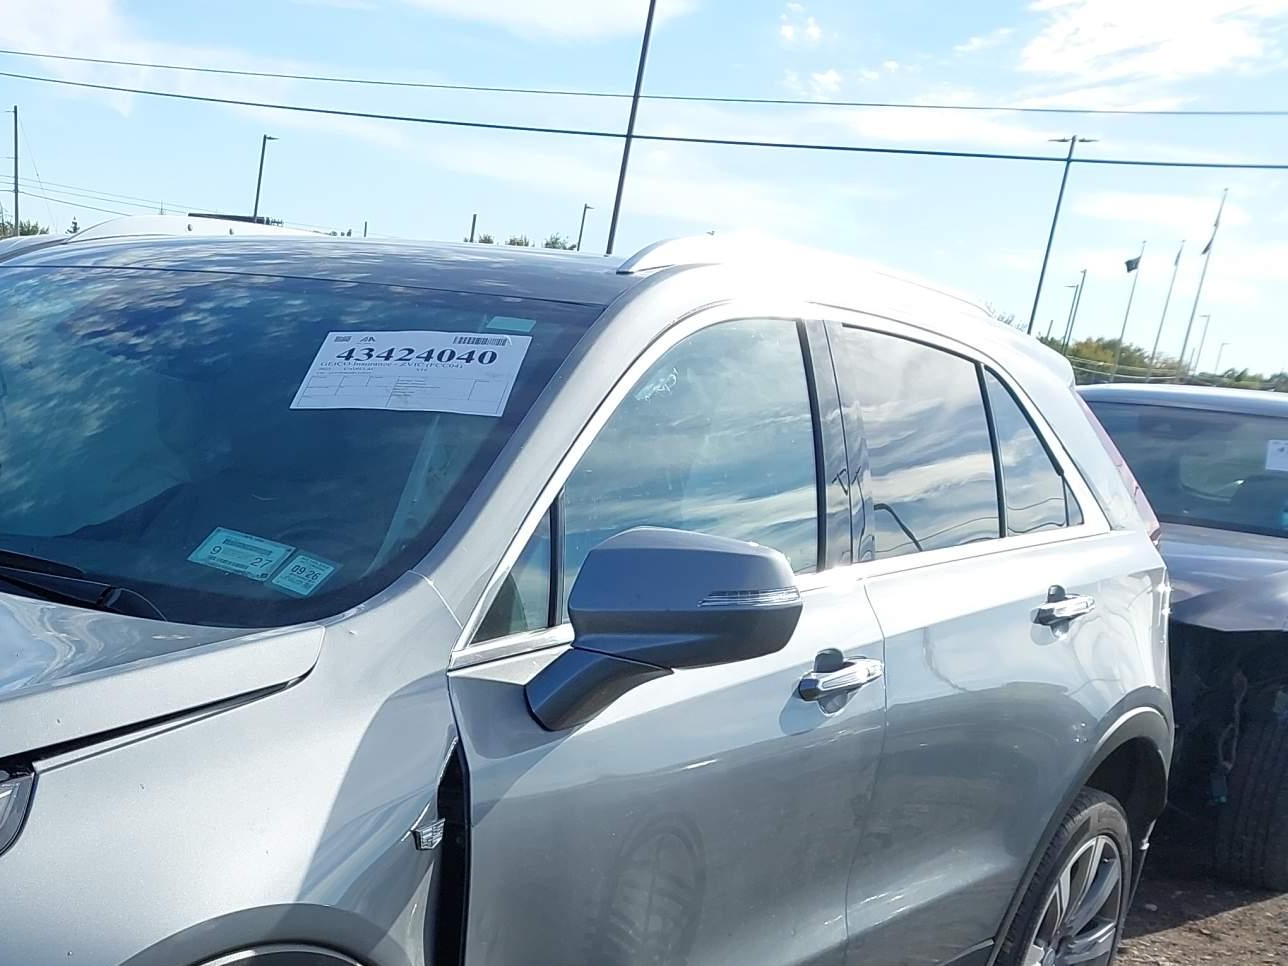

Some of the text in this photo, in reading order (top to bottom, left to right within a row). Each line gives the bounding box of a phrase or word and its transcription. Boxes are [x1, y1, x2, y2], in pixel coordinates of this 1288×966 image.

[336, 347, 497, 365] 43424040
[210, 545, 222, 555] 9
[249, 557, 272, 569] 27
